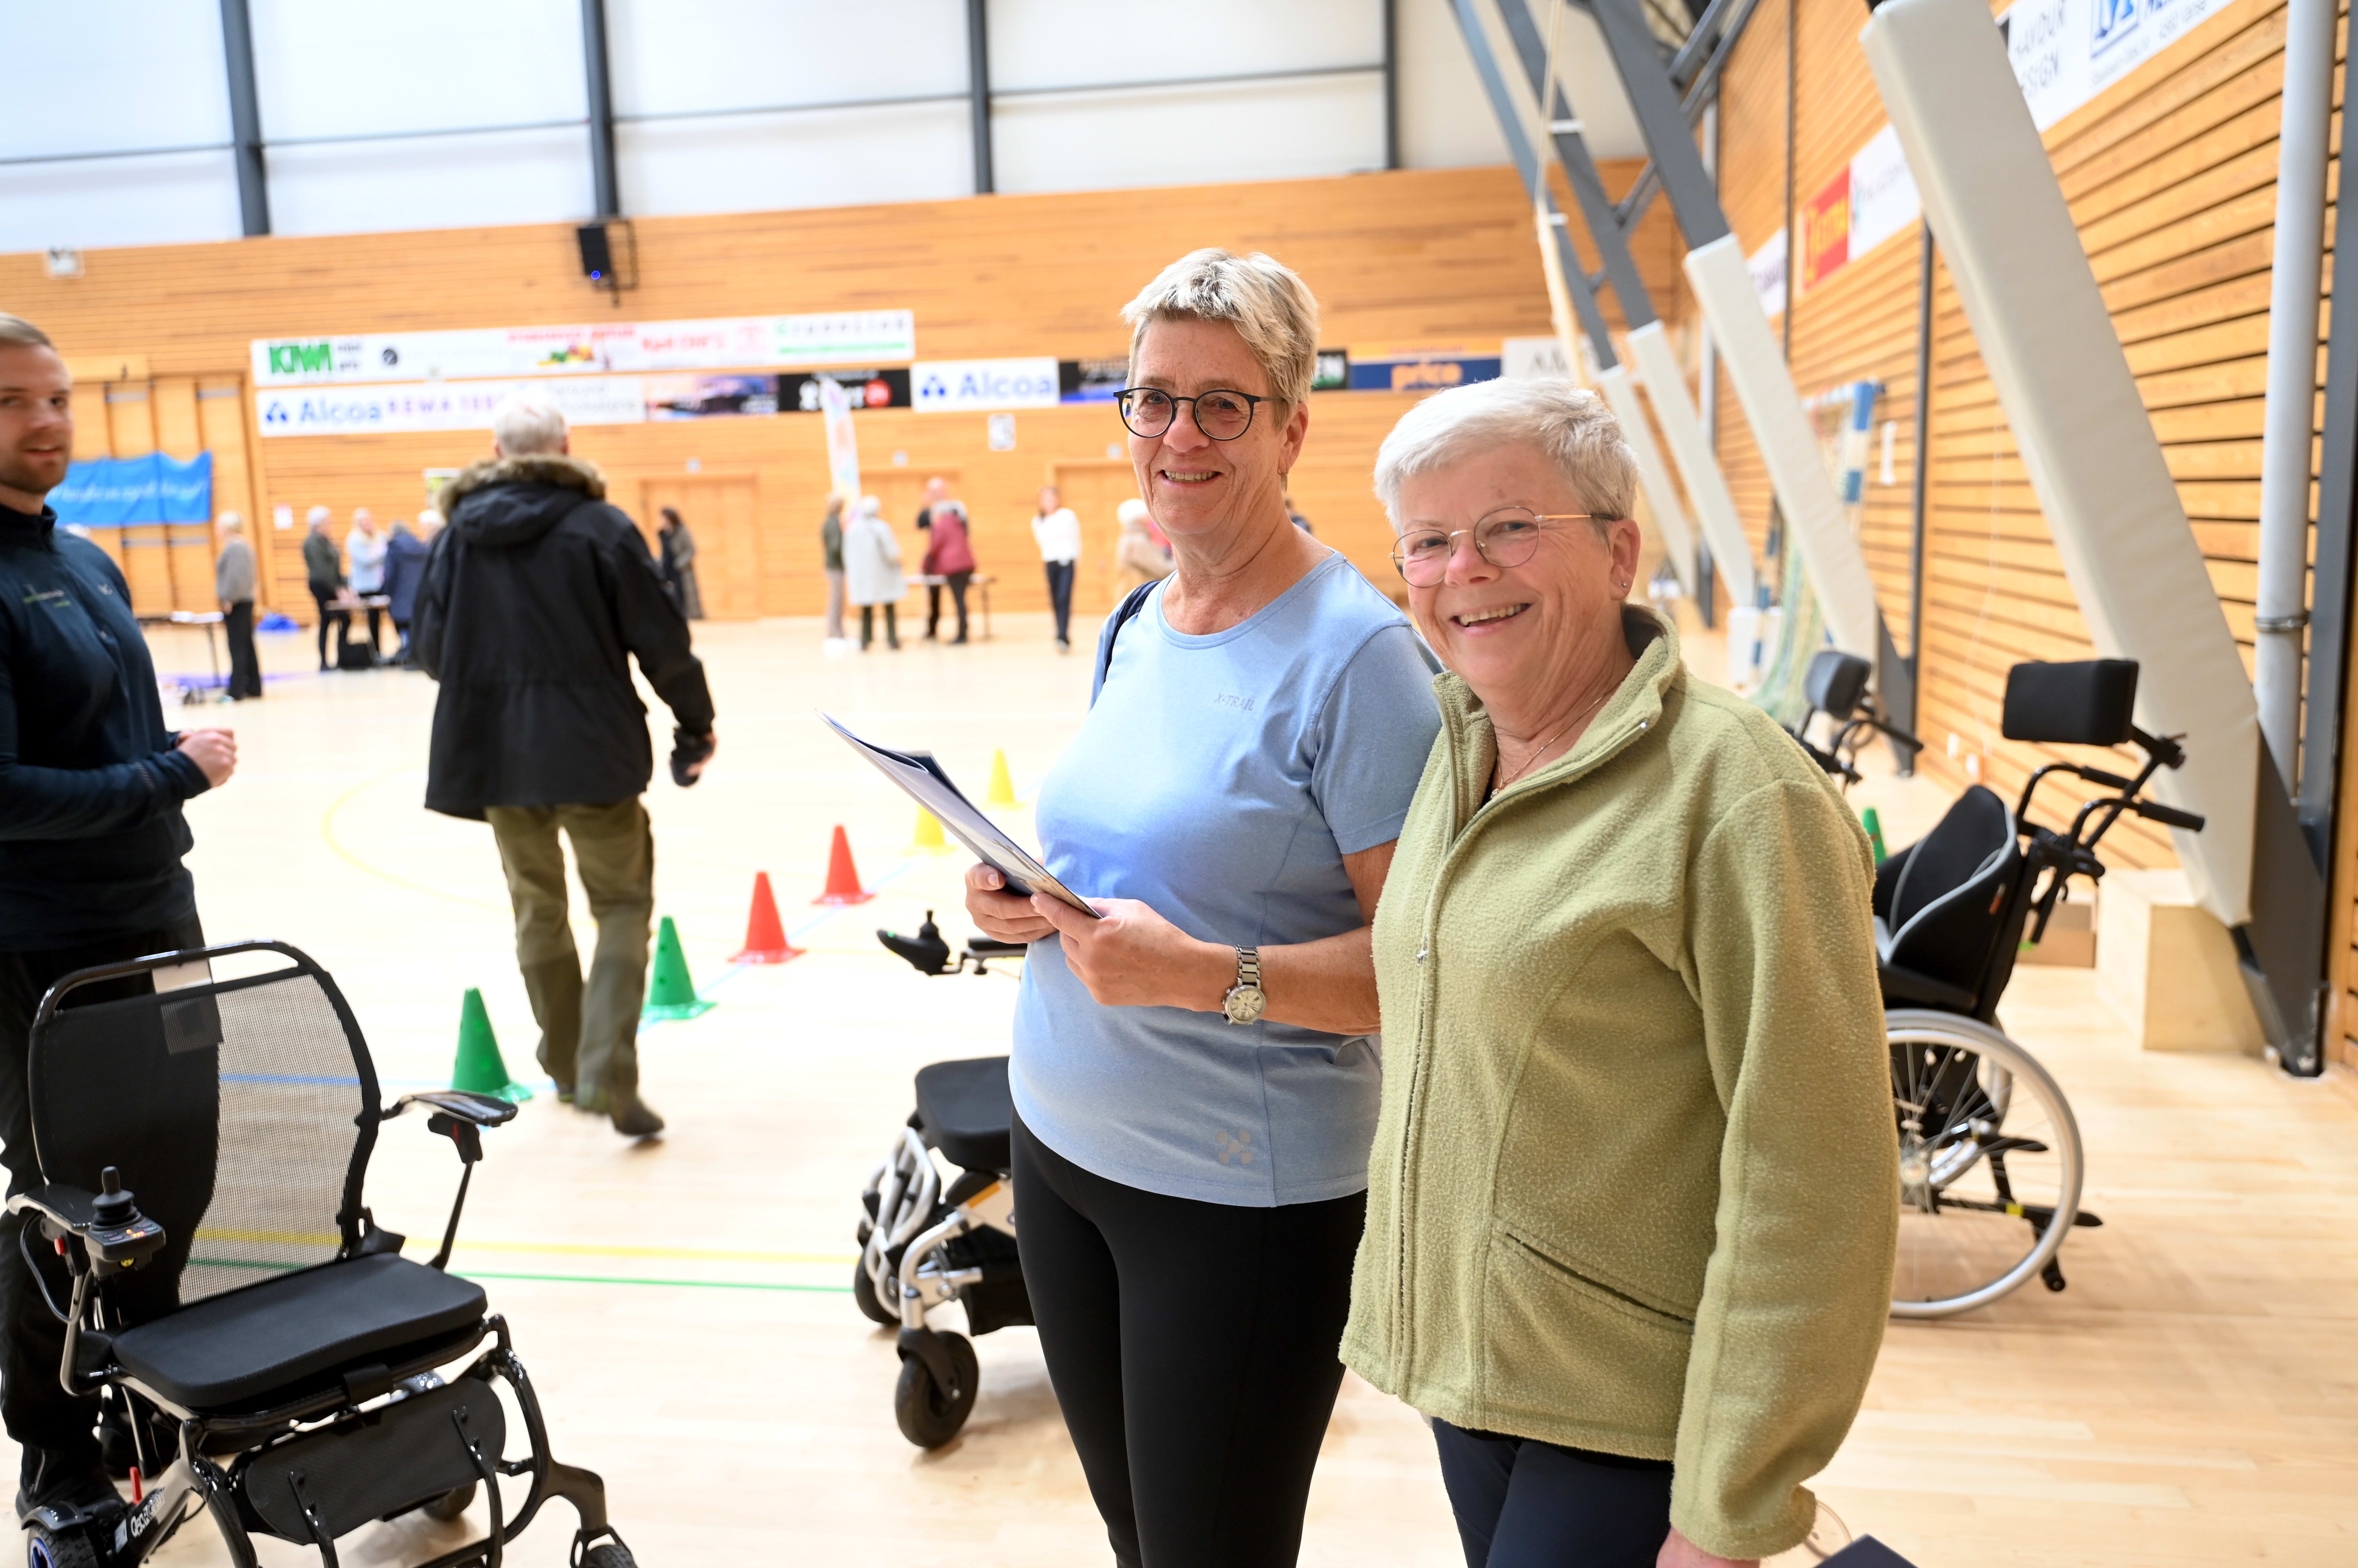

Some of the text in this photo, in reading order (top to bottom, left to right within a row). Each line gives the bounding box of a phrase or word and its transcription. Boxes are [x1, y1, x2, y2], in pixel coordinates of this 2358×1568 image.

[269, 343, 333, 373] KIWI
[957, 369, 1057, 398] Alcoa
[299, 398, 382, 424] Alcoa
[1213, 692, 1254, 711] X-TRAIL
